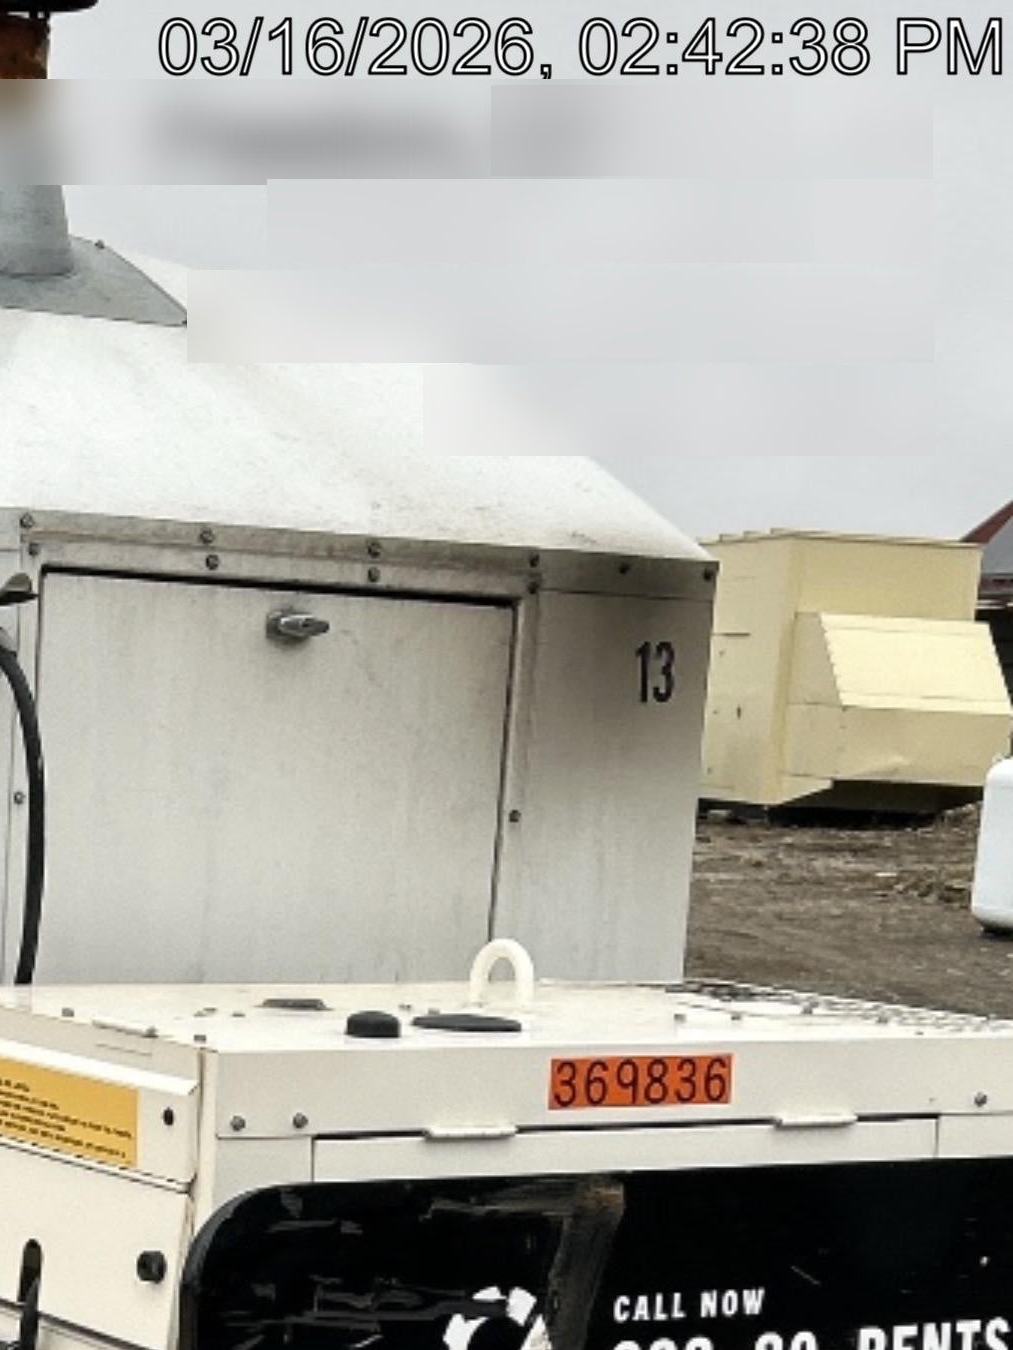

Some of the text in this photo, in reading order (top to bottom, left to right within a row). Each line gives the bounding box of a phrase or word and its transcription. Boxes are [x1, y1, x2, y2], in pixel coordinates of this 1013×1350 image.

[635, 641, 675, 703] 13
[554, 1057, 729, 1107] 369836
[613, 1287, 766, 1322] CALL NOW
